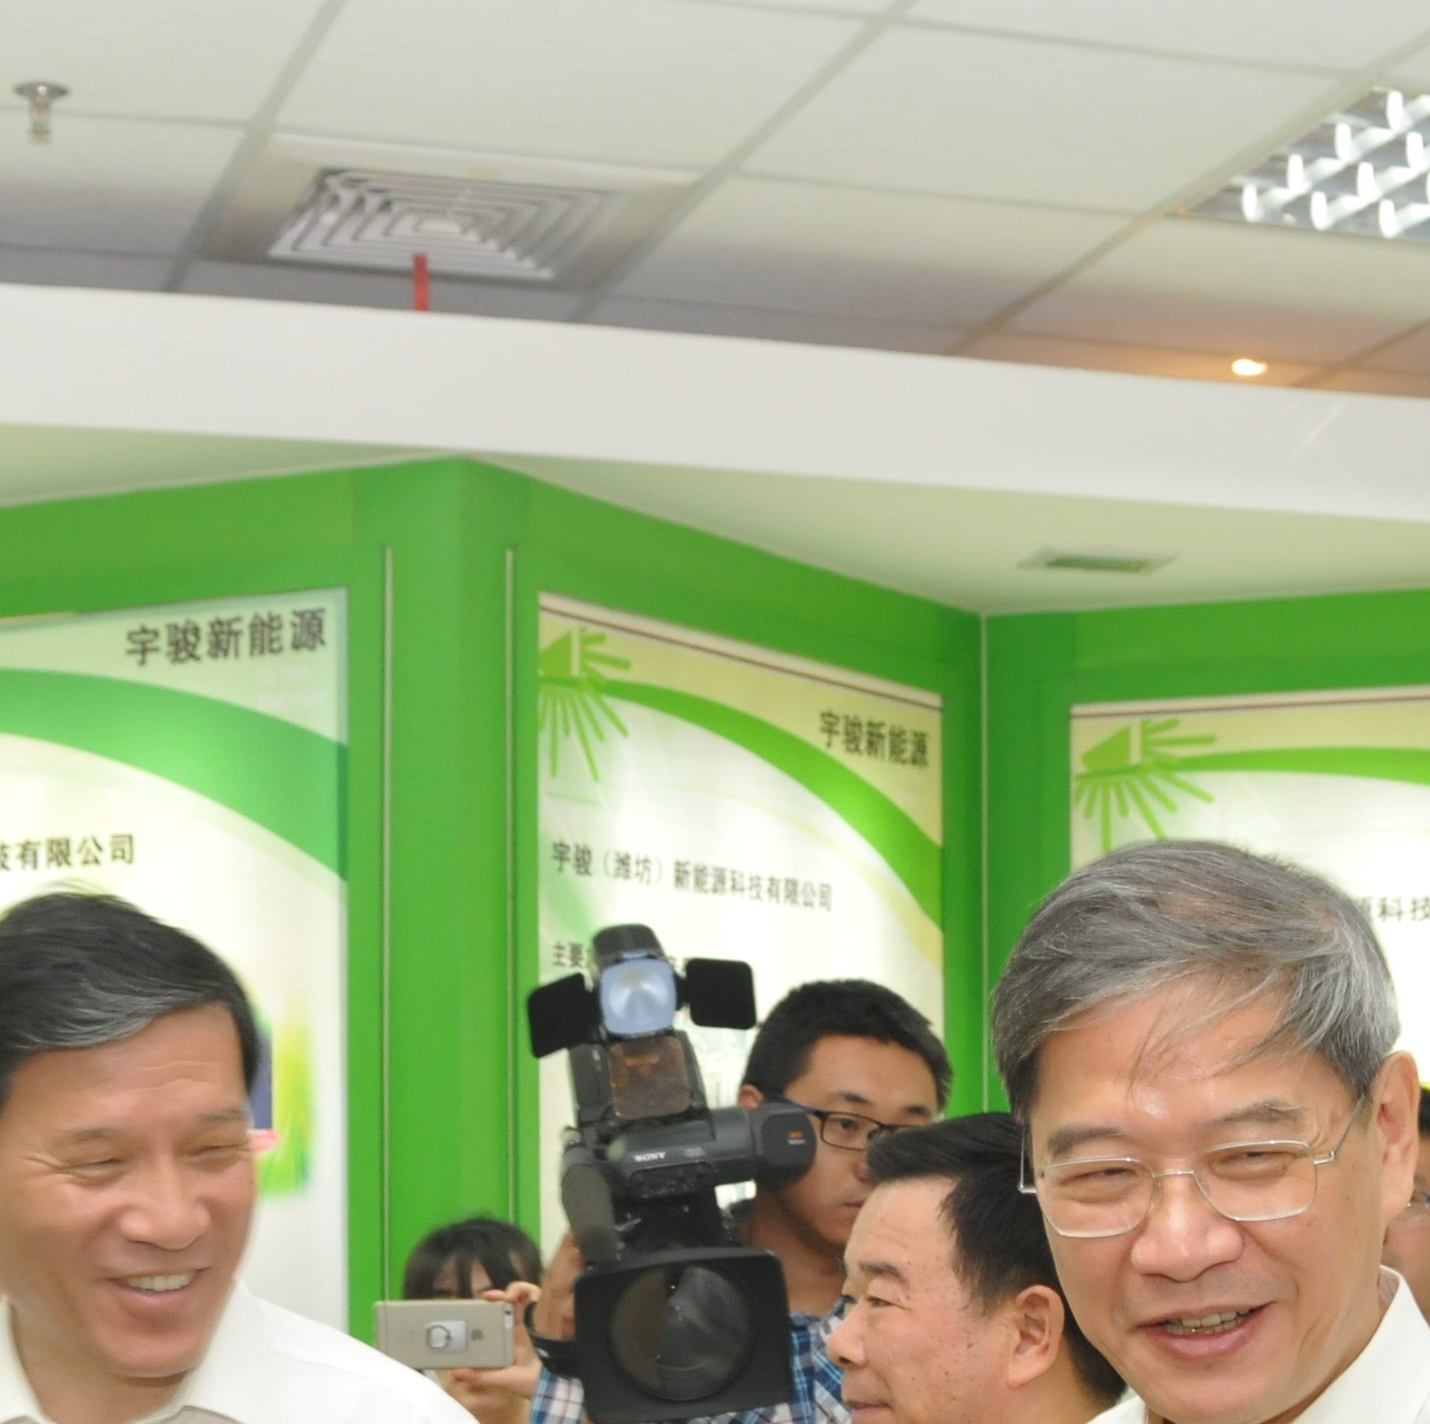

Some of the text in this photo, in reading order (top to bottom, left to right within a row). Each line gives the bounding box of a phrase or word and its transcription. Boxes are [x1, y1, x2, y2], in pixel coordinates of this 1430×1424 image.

[124, 607, 326, 667] 宇骏新能源
[819, 707, 929, 769] 宇骏新能源
[552, 840, 833, 912] 宇骏（潍坊）新能源科技有限公司
[552, 940, 593, 969] 主要
